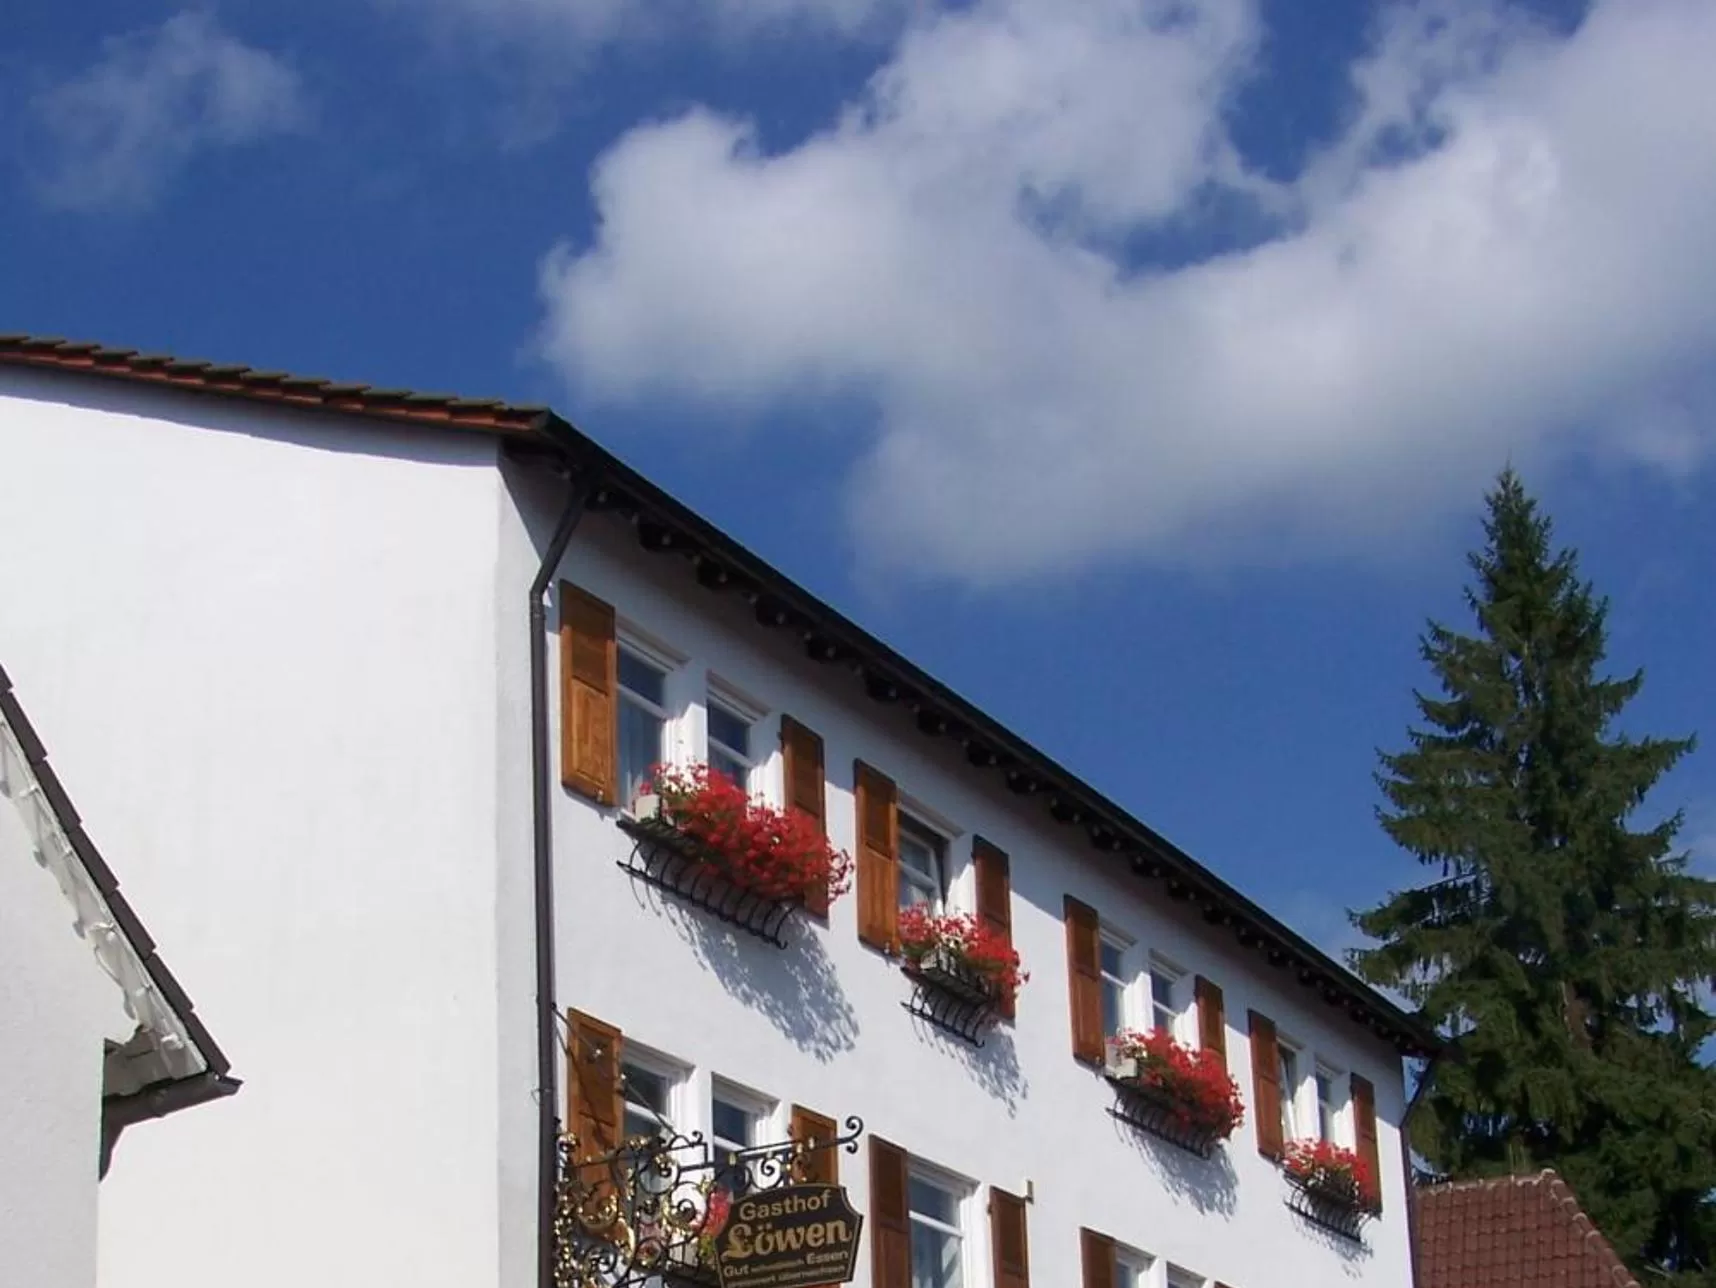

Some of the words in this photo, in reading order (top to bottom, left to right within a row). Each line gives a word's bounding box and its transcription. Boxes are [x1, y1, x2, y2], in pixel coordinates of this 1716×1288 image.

[739, 1189, 832, 1222] Gasthof
[721, 1219, 852, 1263] Löwen
[724, 1263, 750, 1278] Gut
[805, 1250, 849, 1265] Essen
